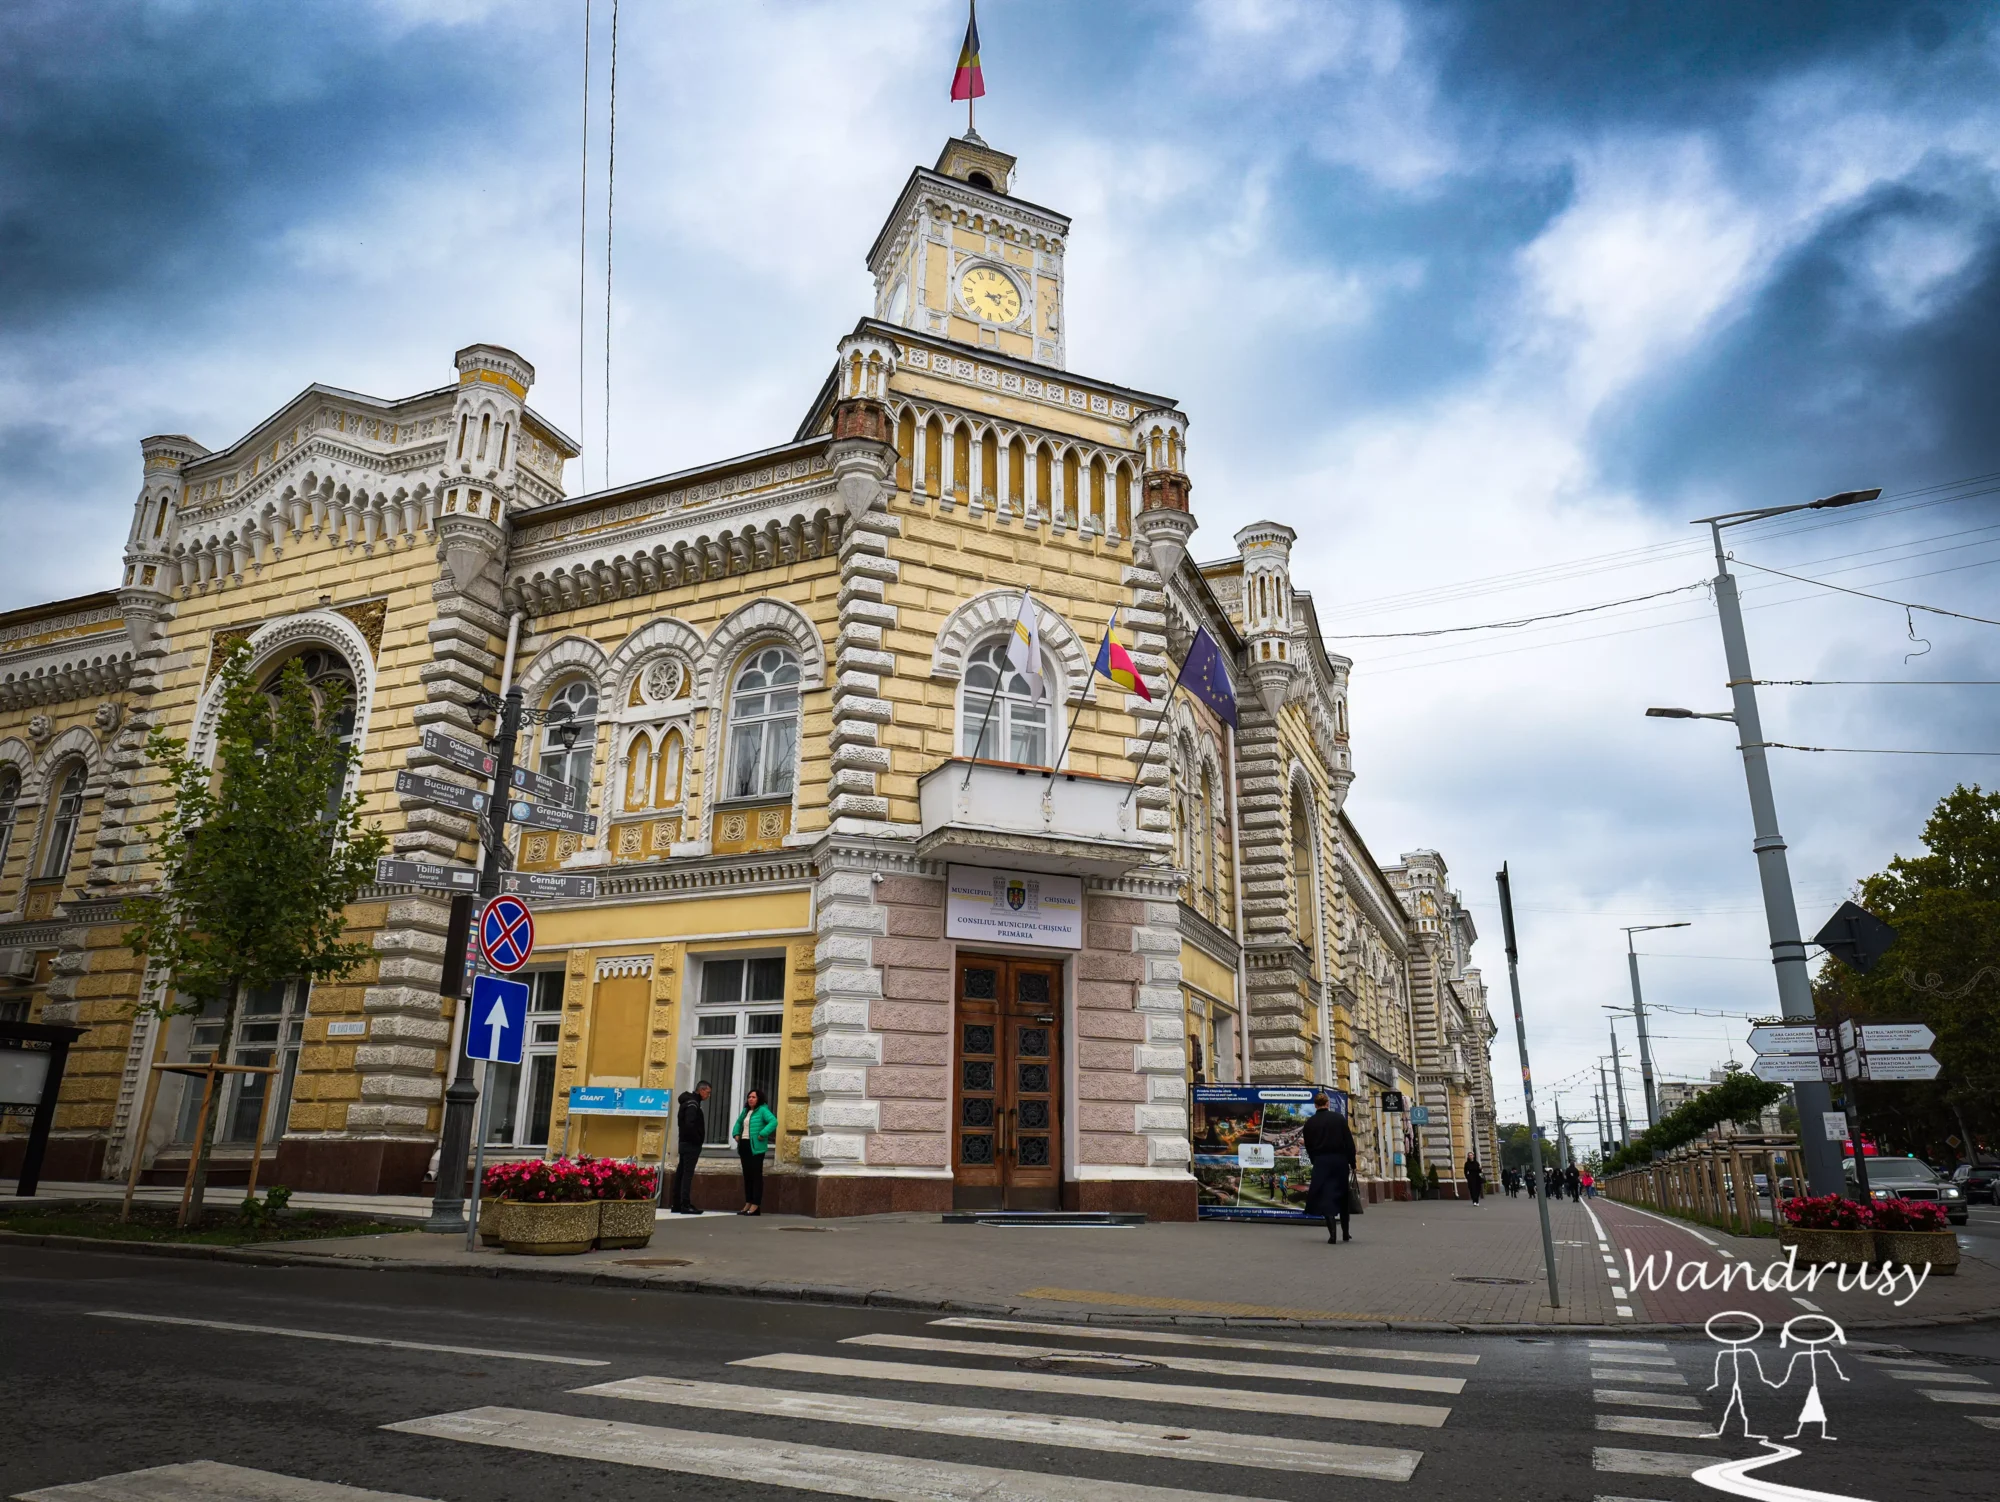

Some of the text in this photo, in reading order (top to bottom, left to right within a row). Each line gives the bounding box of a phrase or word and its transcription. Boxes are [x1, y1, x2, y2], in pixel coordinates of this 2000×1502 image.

[450, 740, 475, 756] Odessa
[405, 778, 412, 789] km
[535, 774, 554, 788] Minsk
[424, 778, 466, 796] București
[536, 806, 574, 820] Grenoble
[590, 820, 596, 830] km
[387, 866, 394, 876] km
[416, 864, 444, 874] Tbilisi
[586, 882, 592, 893] km
[951, 886, 993, 896] MUNICIPIUL
[957, 916, 1072, 933] CONSILIUL MUNICIPAL CHIȘINĂU
[997, 929, 1033, 939] PRIMĂRIA
[579, 1094, 605, 1102] GIANT
[638, 1095, 654, 1104] Liv
